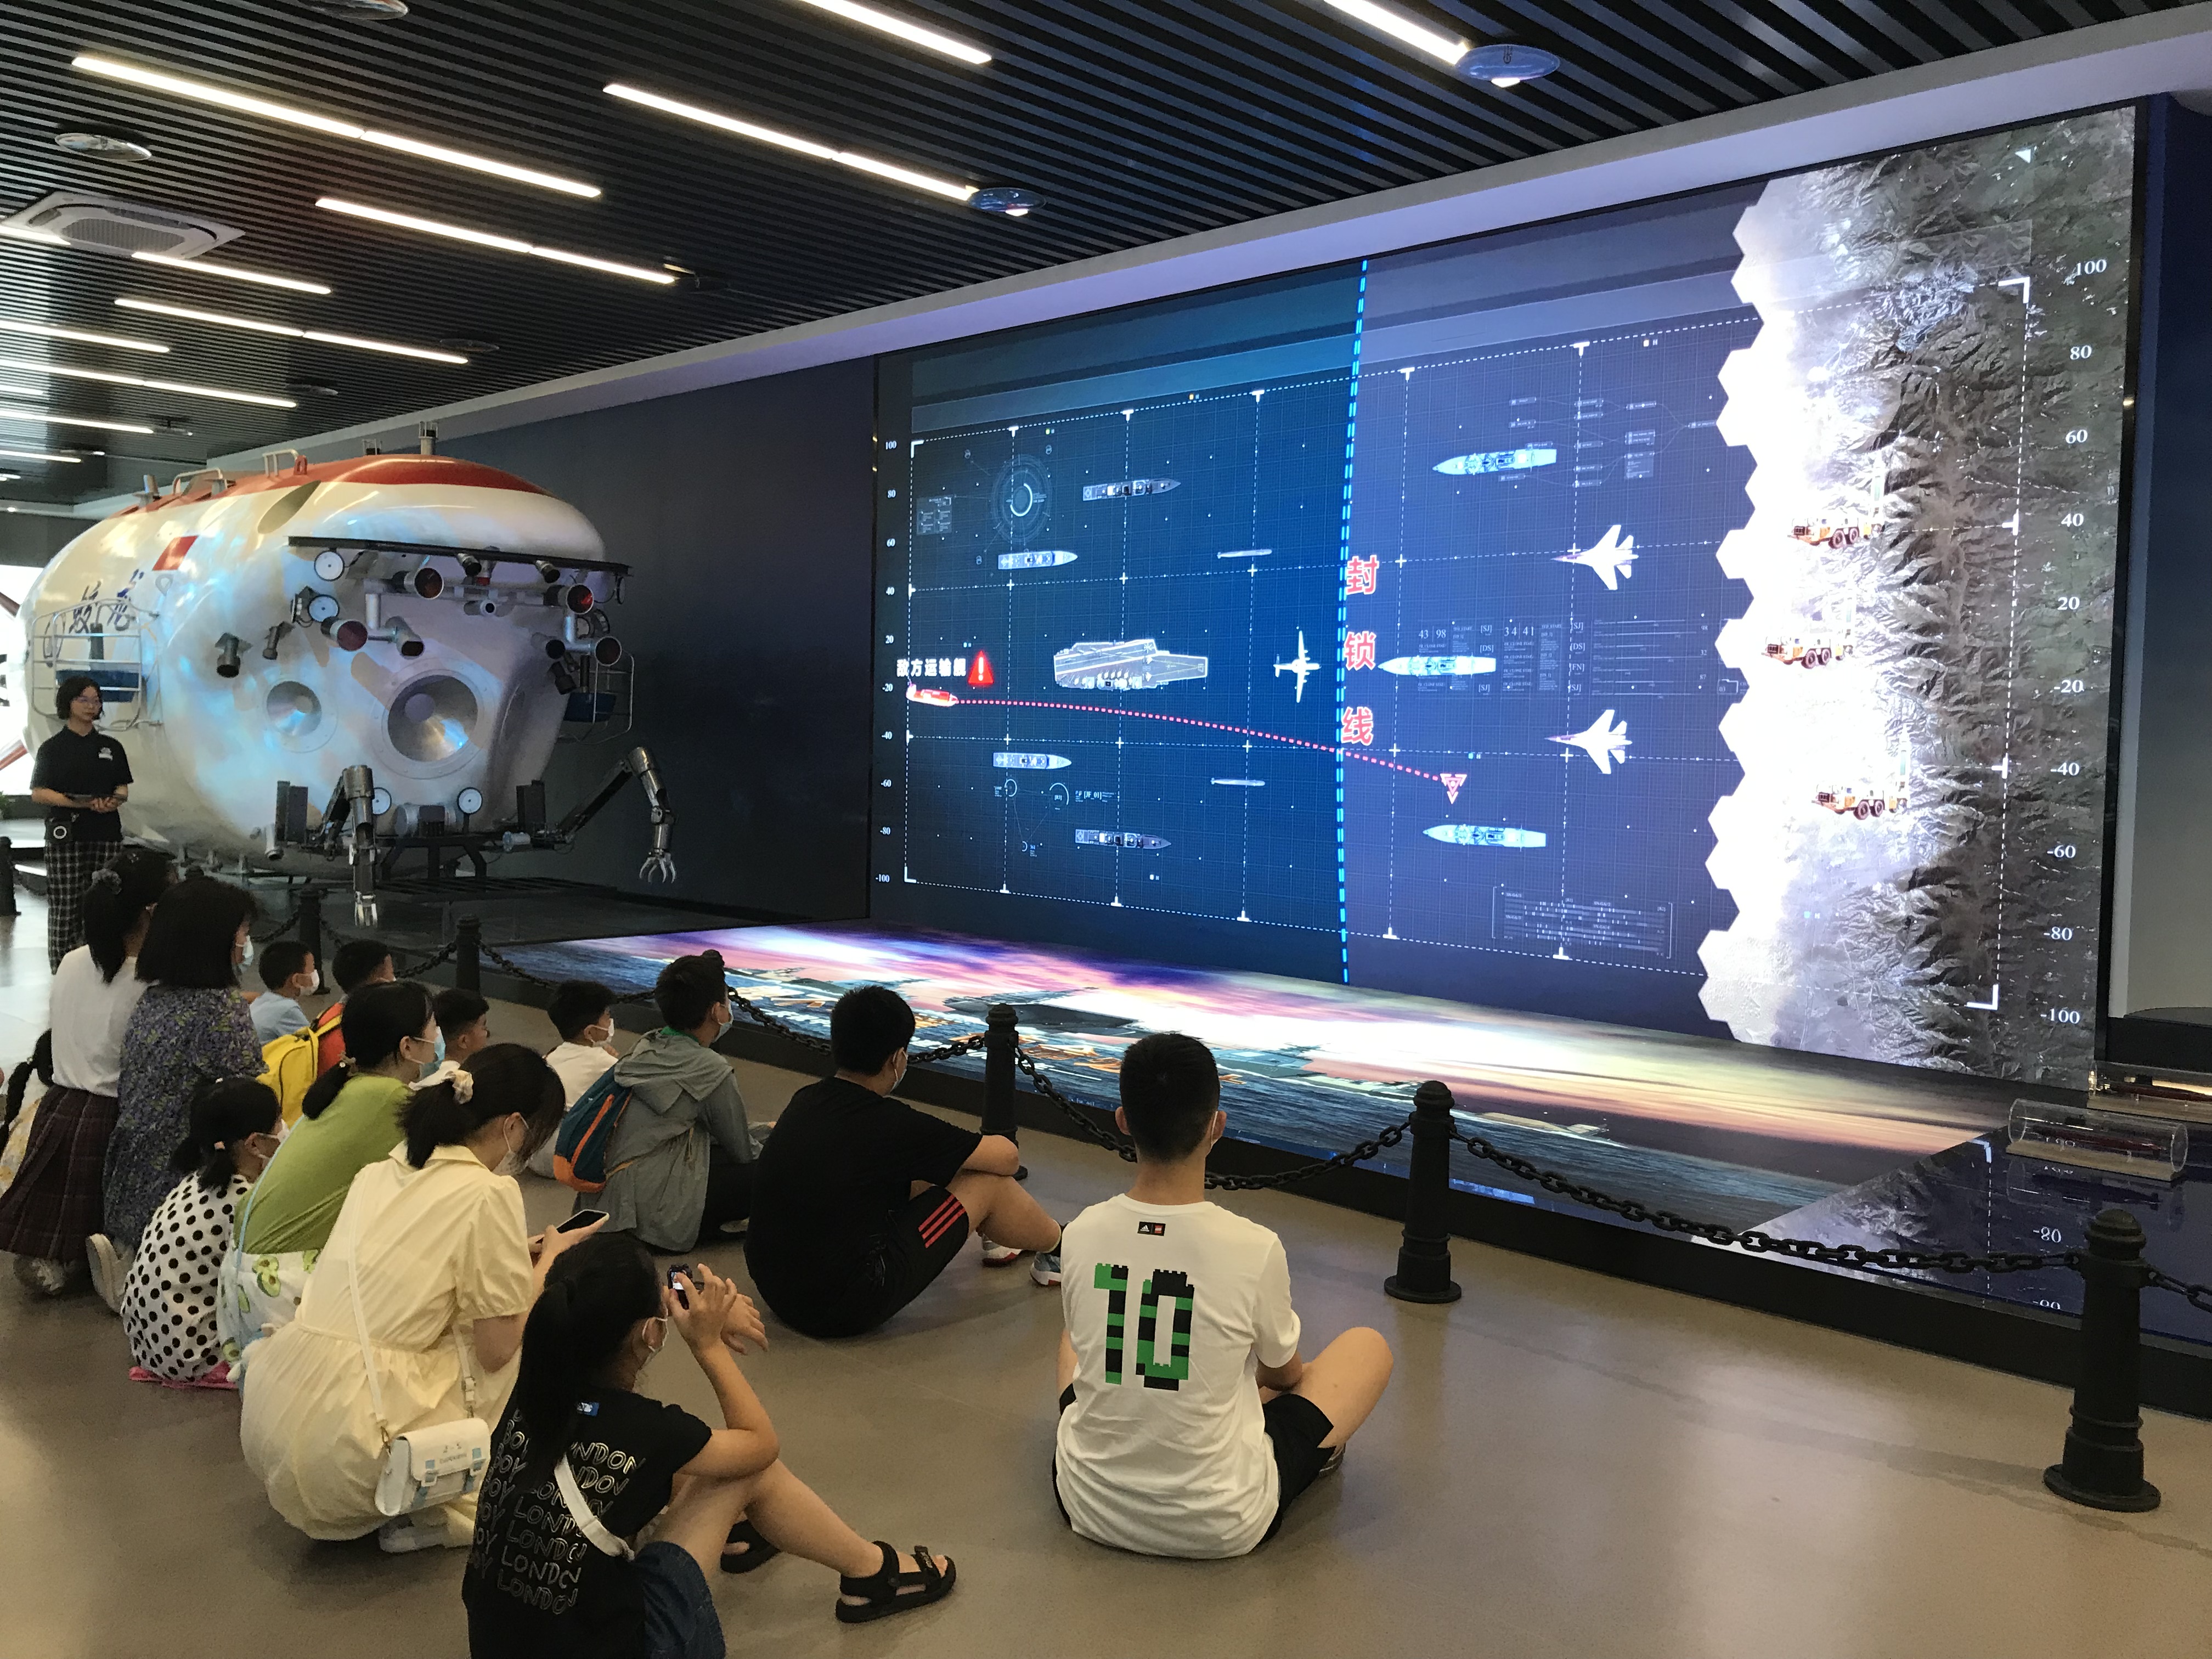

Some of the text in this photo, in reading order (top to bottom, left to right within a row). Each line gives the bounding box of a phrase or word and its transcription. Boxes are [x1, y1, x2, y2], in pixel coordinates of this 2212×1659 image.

[2075, 258, 2107, 275] 100
[2070, 345, 2092, 360] 80
[2066, 429, 2088, 444] 60
[885, 441, 897, 450] 100
[887, 489, 896, 498] 80
[2061, 512, 2084, 527] 40
[887, 538, 896, 548] 60
[885, 586, 895, 595] 40
[2057, 596, 2080, 611] 20
[1418, 629, 1446, 639] 43 98
[1504, 627, 1517, 636] 34
[885, 635, 894, 644] 20
[1342, 555, 1379, 746] 封锁线
[896, 658, 967, 678] 敌方运输舰
[882, 683, 893, 692] -20
[2054, 678, 2084, 694] -20
[882, 731, 893, 740] -40
[2050, 762, 2080, 777] -40
[881, 779, 891, 787] -60
[880, 827, 891, 836] -80
[2047, 845, 2076, 860] -60
[876, 874, 890, 883] -100
[2044, 927, 2073, 941] -80
[2041, 1008, 2080, 1025] -100
[1094, 1262, 1194, 1391] 10
